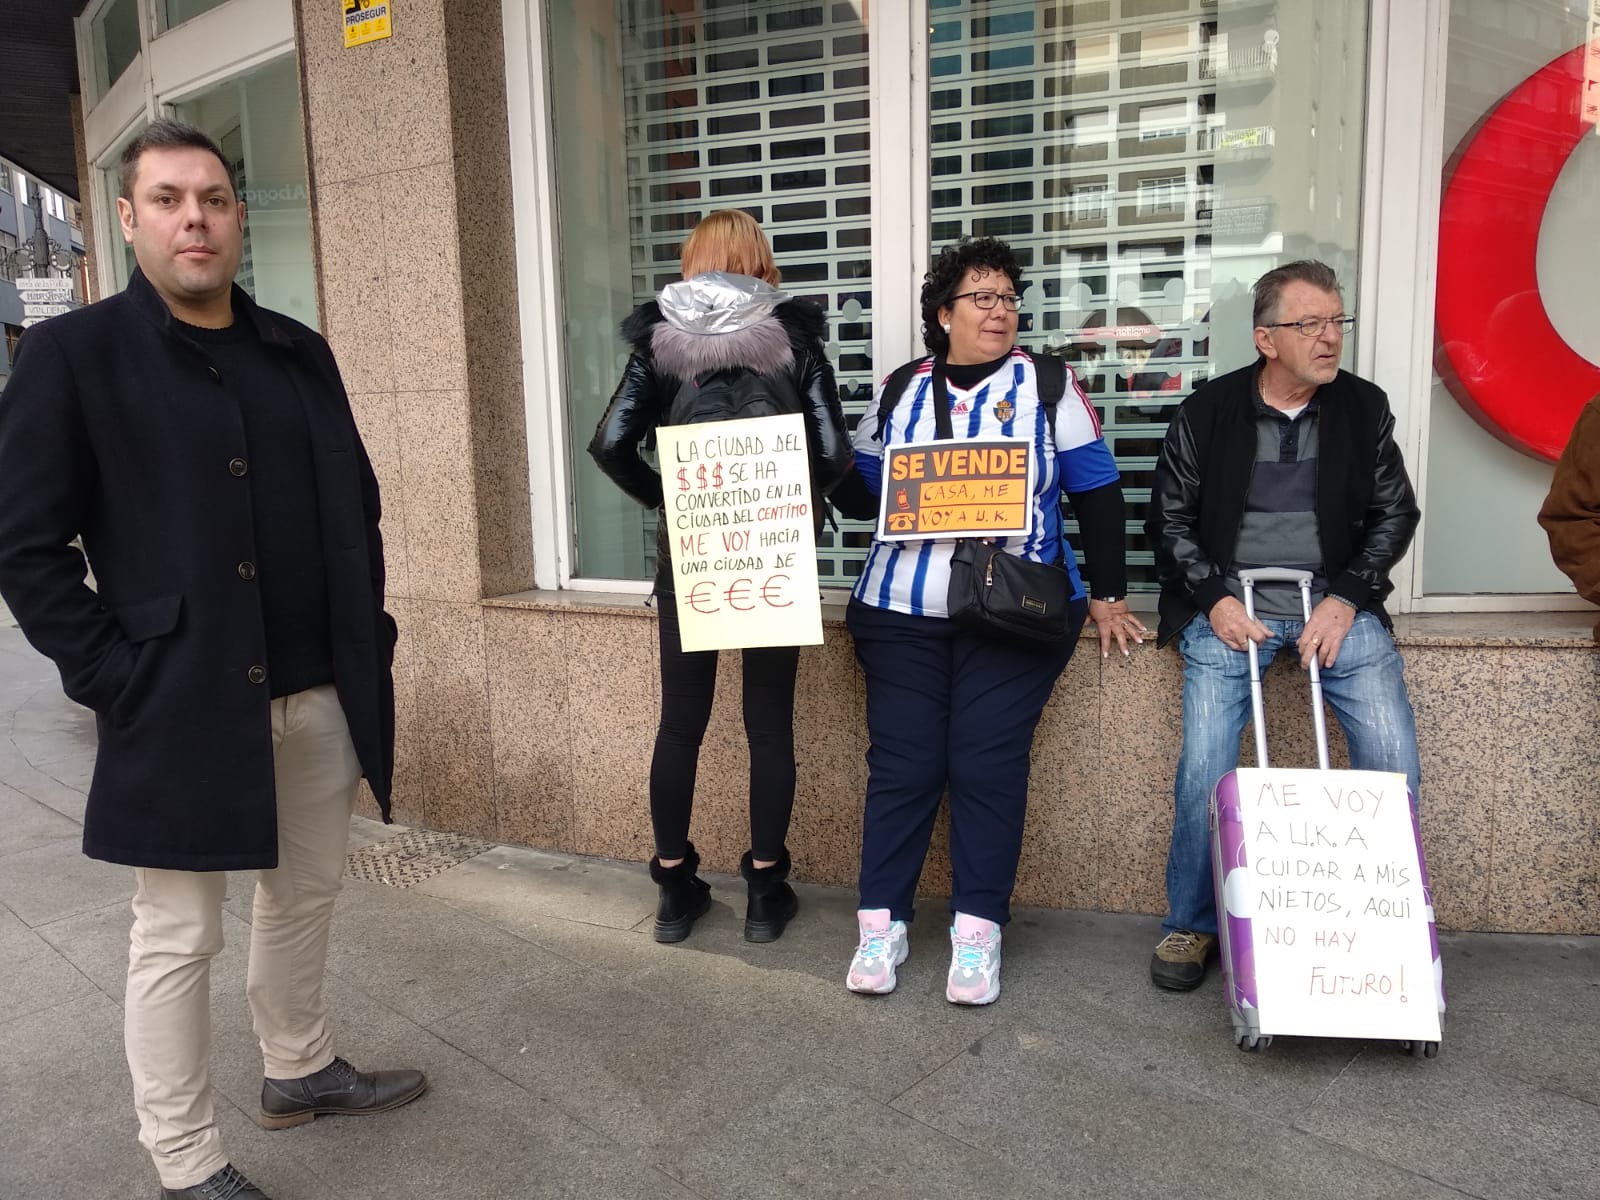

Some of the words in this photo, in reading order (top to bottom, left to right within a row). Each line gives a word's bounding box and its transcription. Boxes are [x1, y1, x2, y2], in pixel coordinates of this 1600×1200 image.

[346, 6, 386, 26] PROSEGUR
[676, 440, 699, 462] LA
[705, 436, 764, 458] CIUDAD
[772, 434, 803, 452] DEL
[729, 462, 748, 483] SE
[755, 462, 778, 480] HA
[892, 453, 925, 481] SE
[932, 448, 1026, 476] VENDE
[676, 488, 760, 511] CONVERTIDO
[767, 485, 782, 499] EN
[787, 484, 802, 496] LA
[924, 484, 976, 501] CASA,
[984, 484, 1009, 499] ME
[677, 512, 729, 529] CIUDAD
[732, 509, 754, 523] DEL
[922, 510, 953, 526] VOY
[957, 511, 966, 522] A
[680, 532, 708, 556] ME
[722, 530, 751, 552] VOY
[760, 528, 799, 547] HACIA
[681, 560, 707, 575] UNA
[714, 556, 764, 571] CIUDAD
[774, 553, 796, 568] DE
[1257, 783, 1300, 807] ME
[1324, 786, 1384, 818] VOY
[1256, 822, 1278, 842] A
[1345, 827, 1368, 850] A
[1256, 857, 1342, 880] CUIDAR
[1354, 864, 1365, 881] A
[1376, 862, 1410, 886] MIS
[1364, 897, 1410, 919] AQUI
[1265, 927, 1295, 945] NO
[1315, 930, 1356, 952] HAY
